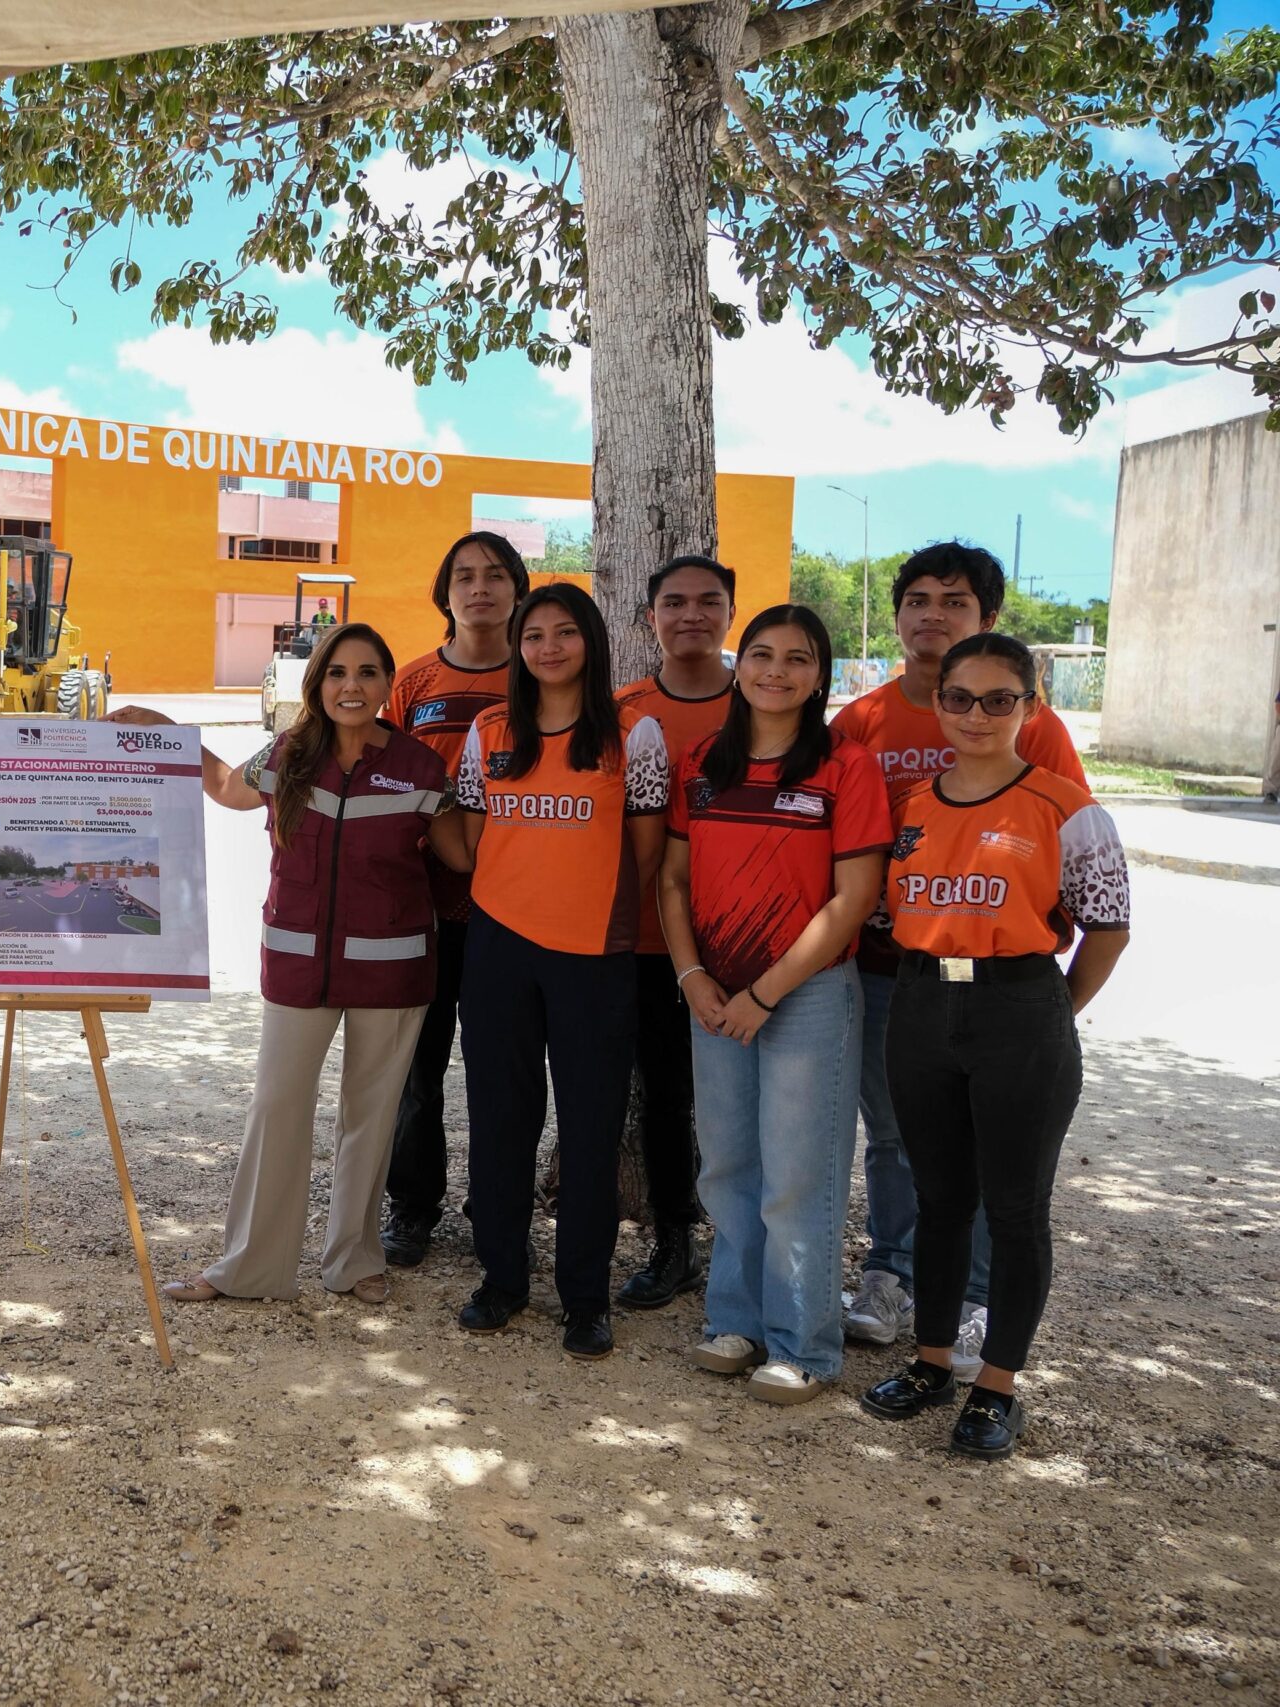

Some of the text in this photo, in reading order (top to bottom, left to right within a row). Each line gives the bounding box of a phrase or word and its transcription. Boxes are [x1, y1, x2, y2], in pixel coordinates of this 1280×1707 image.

[99, 422, 150, 464] DE
[163, 430, 355, 481] QUINTANA
[364, 448, 442, 487] ROO
[414, 701, 446, 721] UTP
[117, 731, 162, 741] NUEVO
[105, 763, 156, 773] INTERNO
[28, 774, 74, 782] QUINTANA
[130, 776, 165, 785] JUÁREZ
[96, 808, 153, 816] $3,000,000.00
[489, 794, 594, 821] UPQROO
[897, 874, 1009, 909] PQROO
